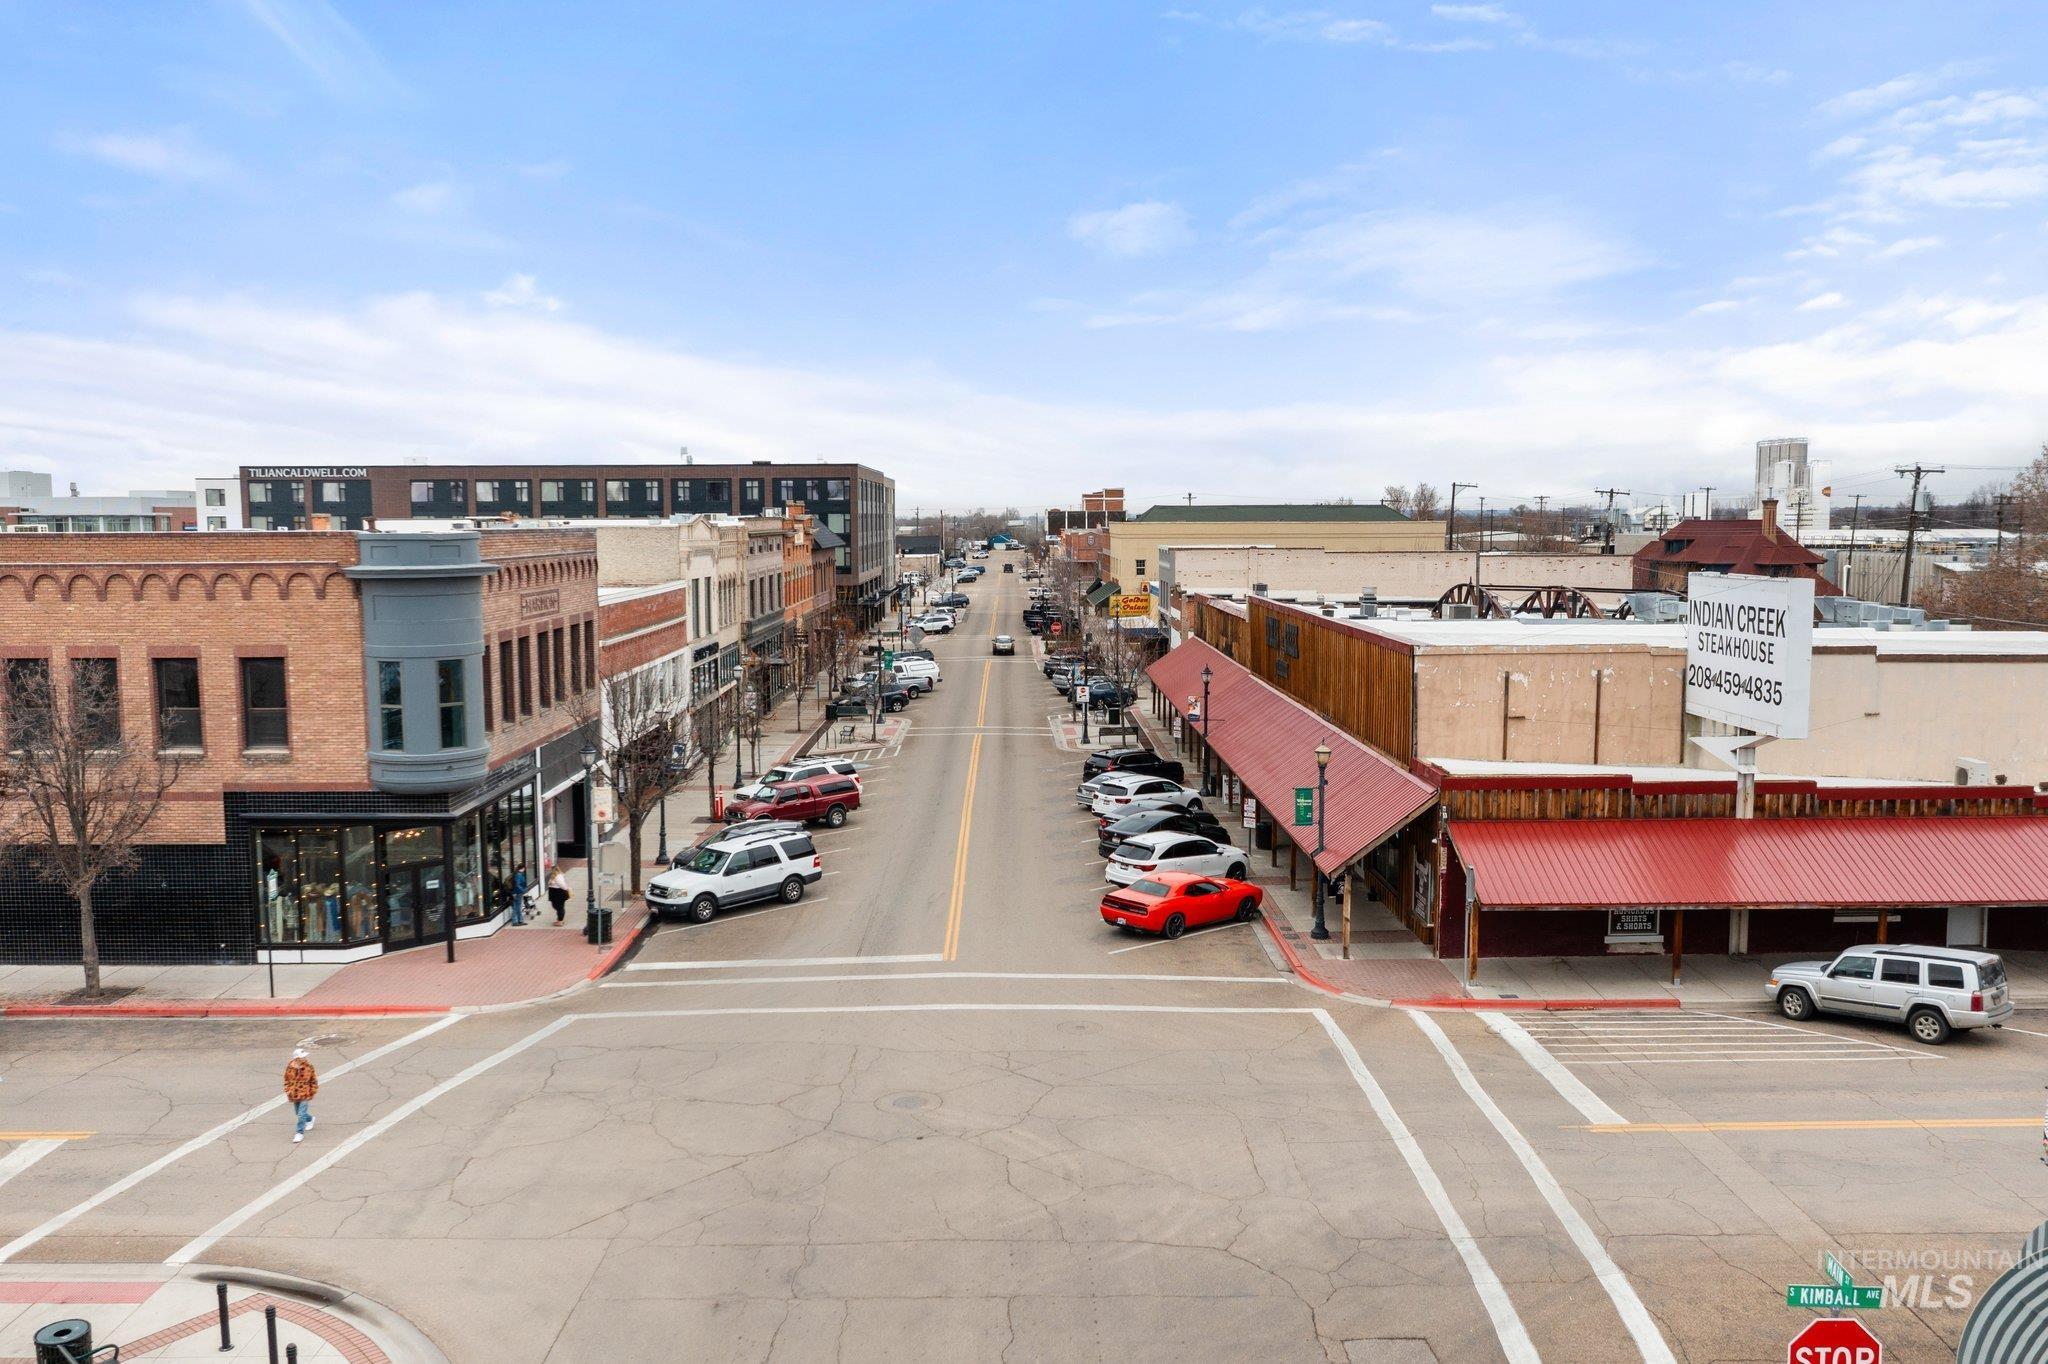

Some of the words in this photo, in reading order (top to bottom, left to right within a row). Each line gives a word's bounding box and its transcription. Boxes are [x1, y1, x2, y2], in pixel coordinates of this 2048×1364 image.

[248, 468, 367, 478] TILIANCALDWELL.COM
[1689, 599, 1734, 630] INDIAN
[1737, 604, 1786, 638] CREEK
[1697, 631, 1775, 664] STEAKHOUSE
[1827, 1256, 1844, 1286] MAIN
[1789, 1287, 1795, 1297] S
[1800, 1288, 1860, 1306] KIMBALL
[1866, 1290, 1880, 1299] AVE
